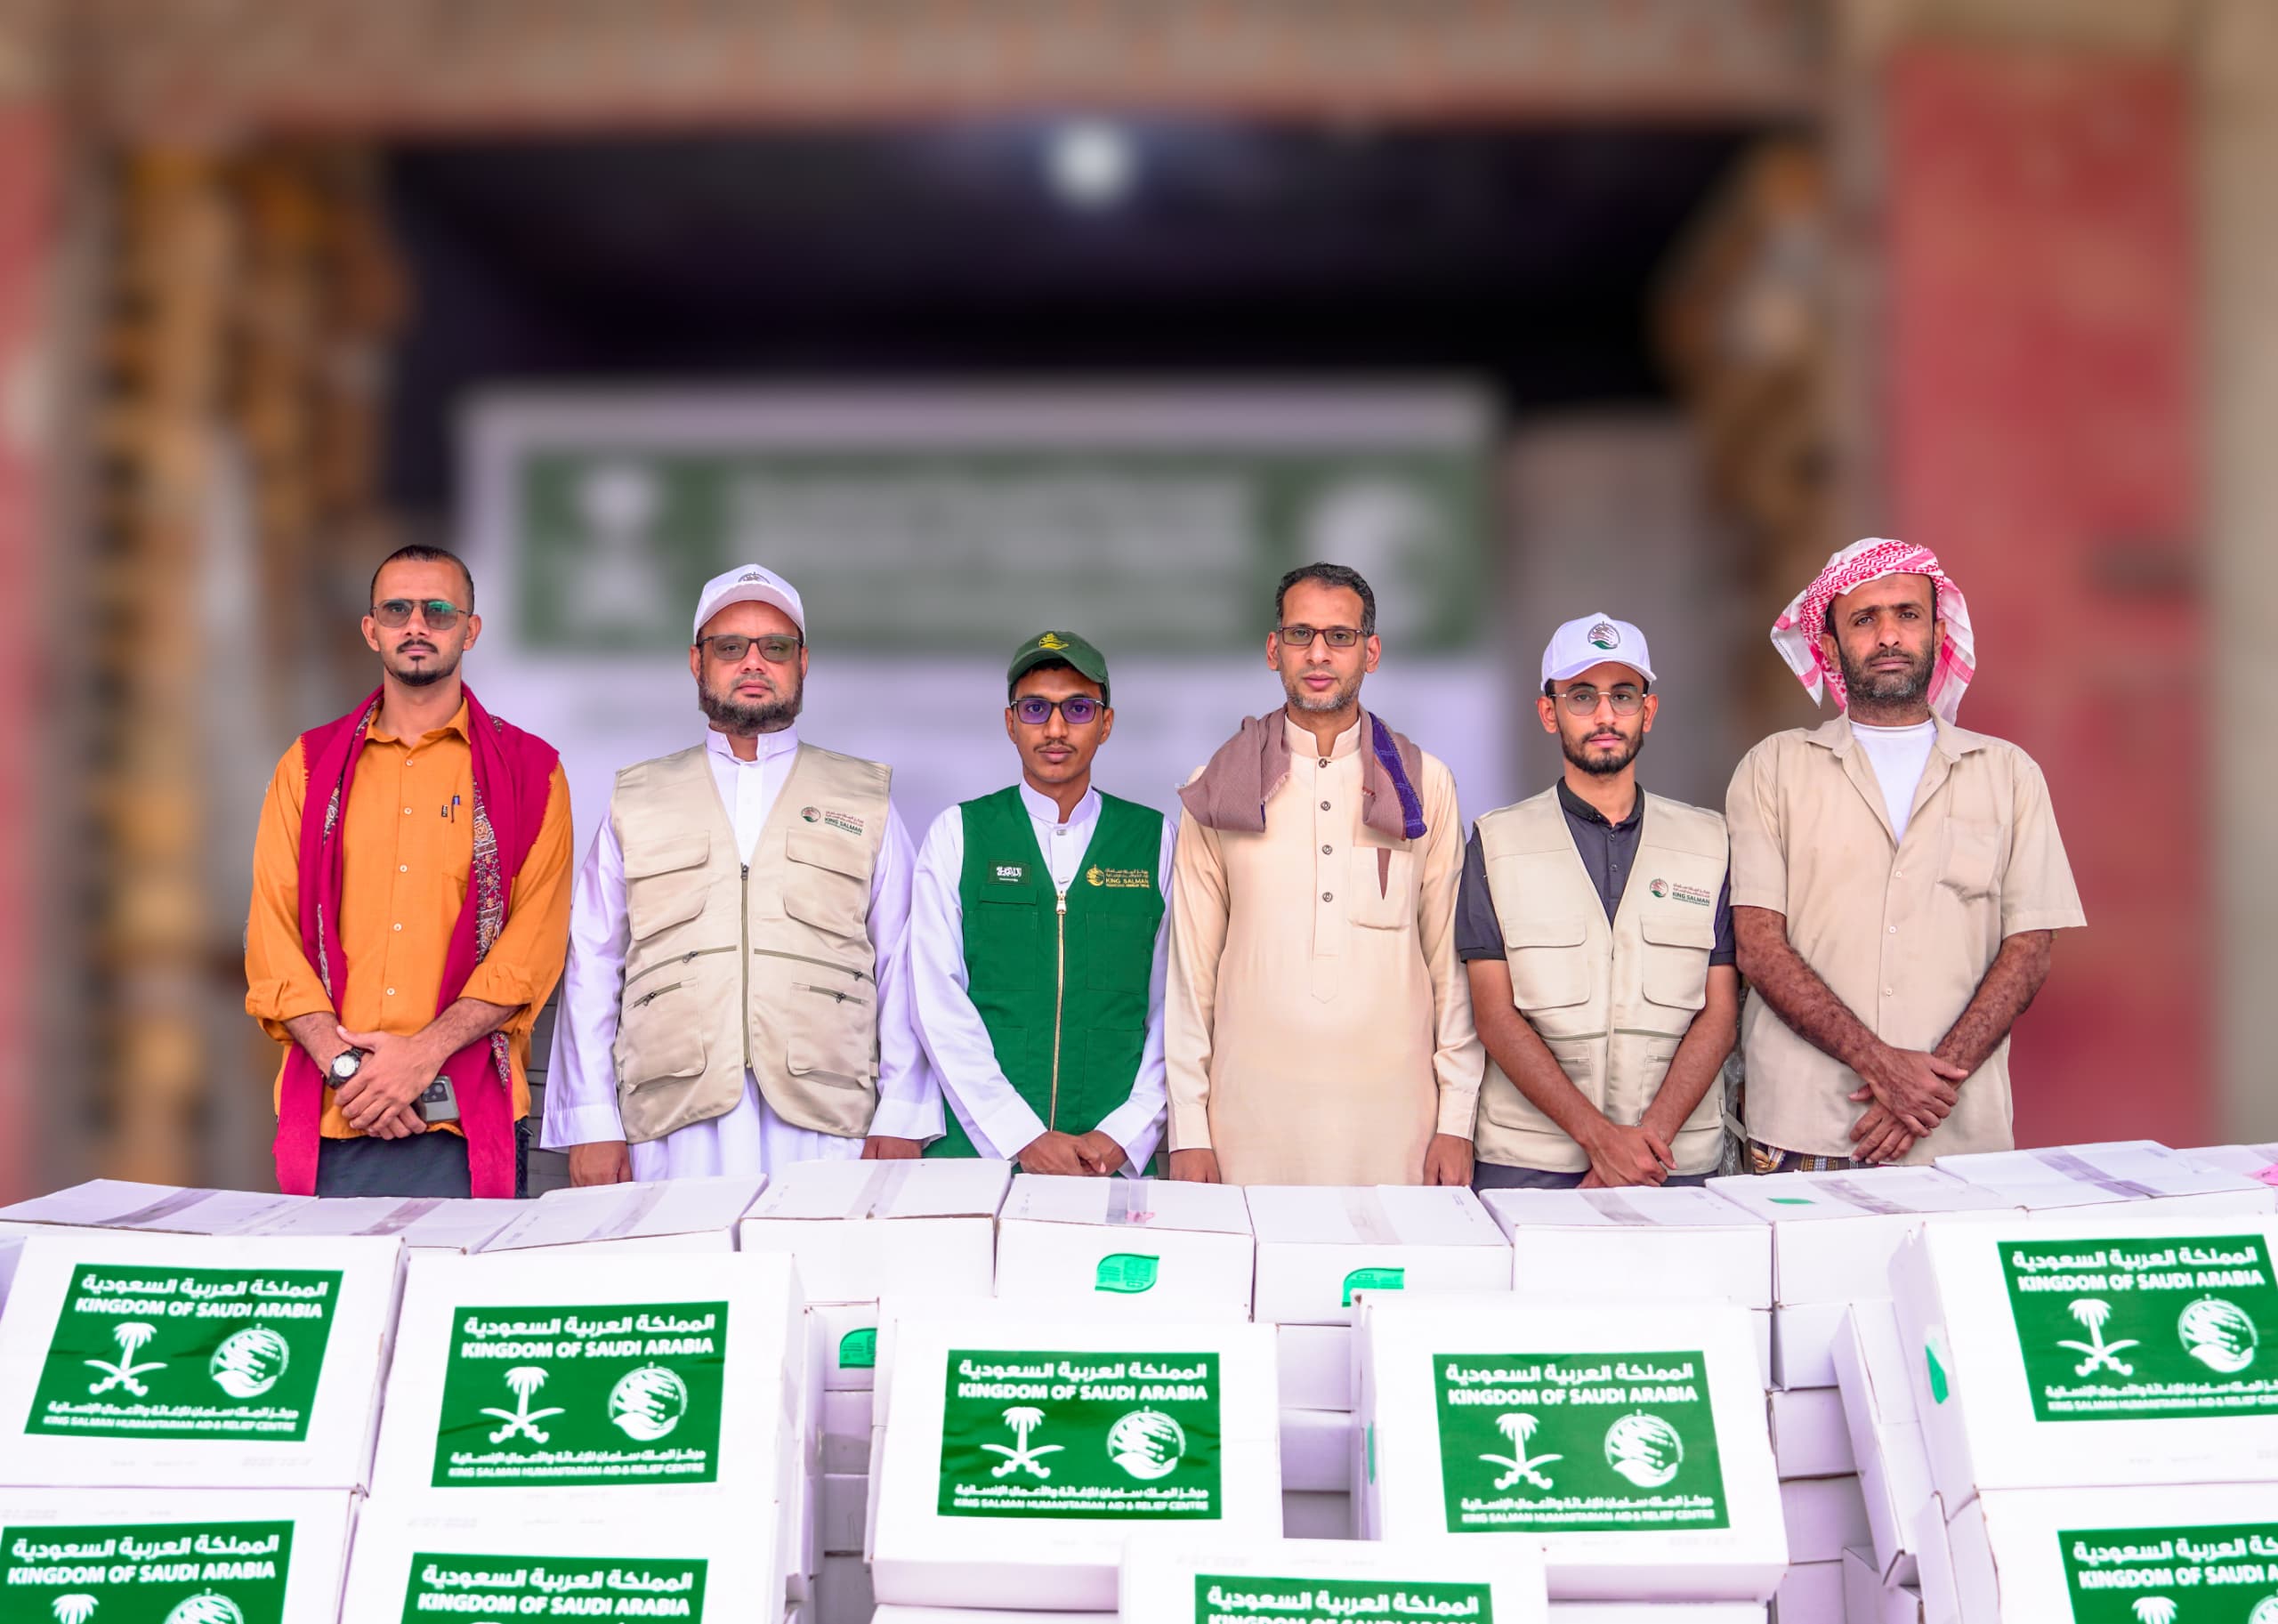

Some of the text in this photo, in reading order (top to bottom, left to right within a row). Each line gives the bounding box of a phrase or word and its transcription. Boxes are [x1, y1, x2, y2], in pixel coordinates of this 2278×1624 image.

[825, 817, 838, 825] KING
[840, 820, 862, 833] SALMAN
[1686, 894, 1710, 904] SALMAN
[2013, 1247, 2257, 1272] المملكة العربية السعودية
[83, 1274, 327, 1298] المملكة العربية السعودية
[2018, 1270, 2265, 1291] KINGDOM OF SAUDI ARABIA
[76, 1298, 322, 1317] KINGDOM OF SAUDI ARABIA
[464, 1314, 715, 1338] المملكة العربية السعودية
[462, 1338, 714, 1358] KINGDOM OF SAUDI ARABIA
[959, 1360, 1207, 1382] المملكة العربية السعودية
[1446, 1362, 1693, 1386] المملكة العربية السعودية
[958, 1383, 1208, 1400] KINGDOM OF SAUDI ARABIA
[1448, 1386, 1698, 1405] KINGDOM OF SAUDI ARABIA
[2048, 1400, 2075, 1411] KING
[2074, 1400, 2119, 1411] SALMAN
[2118, 1398, 2198, 1410] HUMANITARIAN
[2197, 1396, 2217, 1408] AID
[2224, 1394, 2258, 1406] RELIEF
[43, 1416, 69, 1426] KING
[71, 1416, 115, 1427] SALMAN
[116, 1418, 195, 1429] HUMANITARIAN
[195, 1420, 214, 1430] AID
[222, 1420, 256, 1430] RELIEF
[255, 1420, 295, 1432] CENTRE
[448, 1466, 474, 1477] KING
[476, 1466, 521, 1477] SALMAN
[521, 1466, 602, 1476] HUMANITARIAN
[602, 1465, 622, 1475] AID
[630, 1464, 665, 1475] RELIEF
[665, 1462, 704, 1474] CENTRE
[953, 1498, 980, 1507] KING
[981, 1499, 1025, 1508] SALMAN
[1027, 1500, 1105, 1509] HUMANITARIAN
[1108, 1500, 1126, 1510] AID
[1135, 1500, 1167, 1510] RELIEF
[1168, 1500, 1208, 1511] CENTRE
[1461, 1512, 1489, 1524] KING
[1489, 1512, 1534, 1523] SALMAN
[1533, 1511, 1614, 1523] HUMANITARIAN
[1614, 1510, 1633, 1522] AID
[1641, 1509, 1676, 1522] RELIEF
[1675, 1508, 1715, 1521] CENTRE
[12, 1535, 279, 1562] المملكة العربية السعودية
[2073, 1541, 2173, 1565] السعودية
[2176, 1539, 2246, 1562] العربية
[8, 1562, 275, 1584] KINGDOM OF SAUDI ARABIA
[423, 1564, 692, 1592] المملكة العربية السعودية
[2079, 1569, 2173, 1588] KINGDOM
[2176, 1567, 2201, 1585] OF
[2205, 1565, 2265, 1584] SAUDI
[418, 1593, 690, 1615] KINGDOM OF SAUDI ARABIA
[1208, 1586, 1479, 1616] المملكة العربية السعودية
